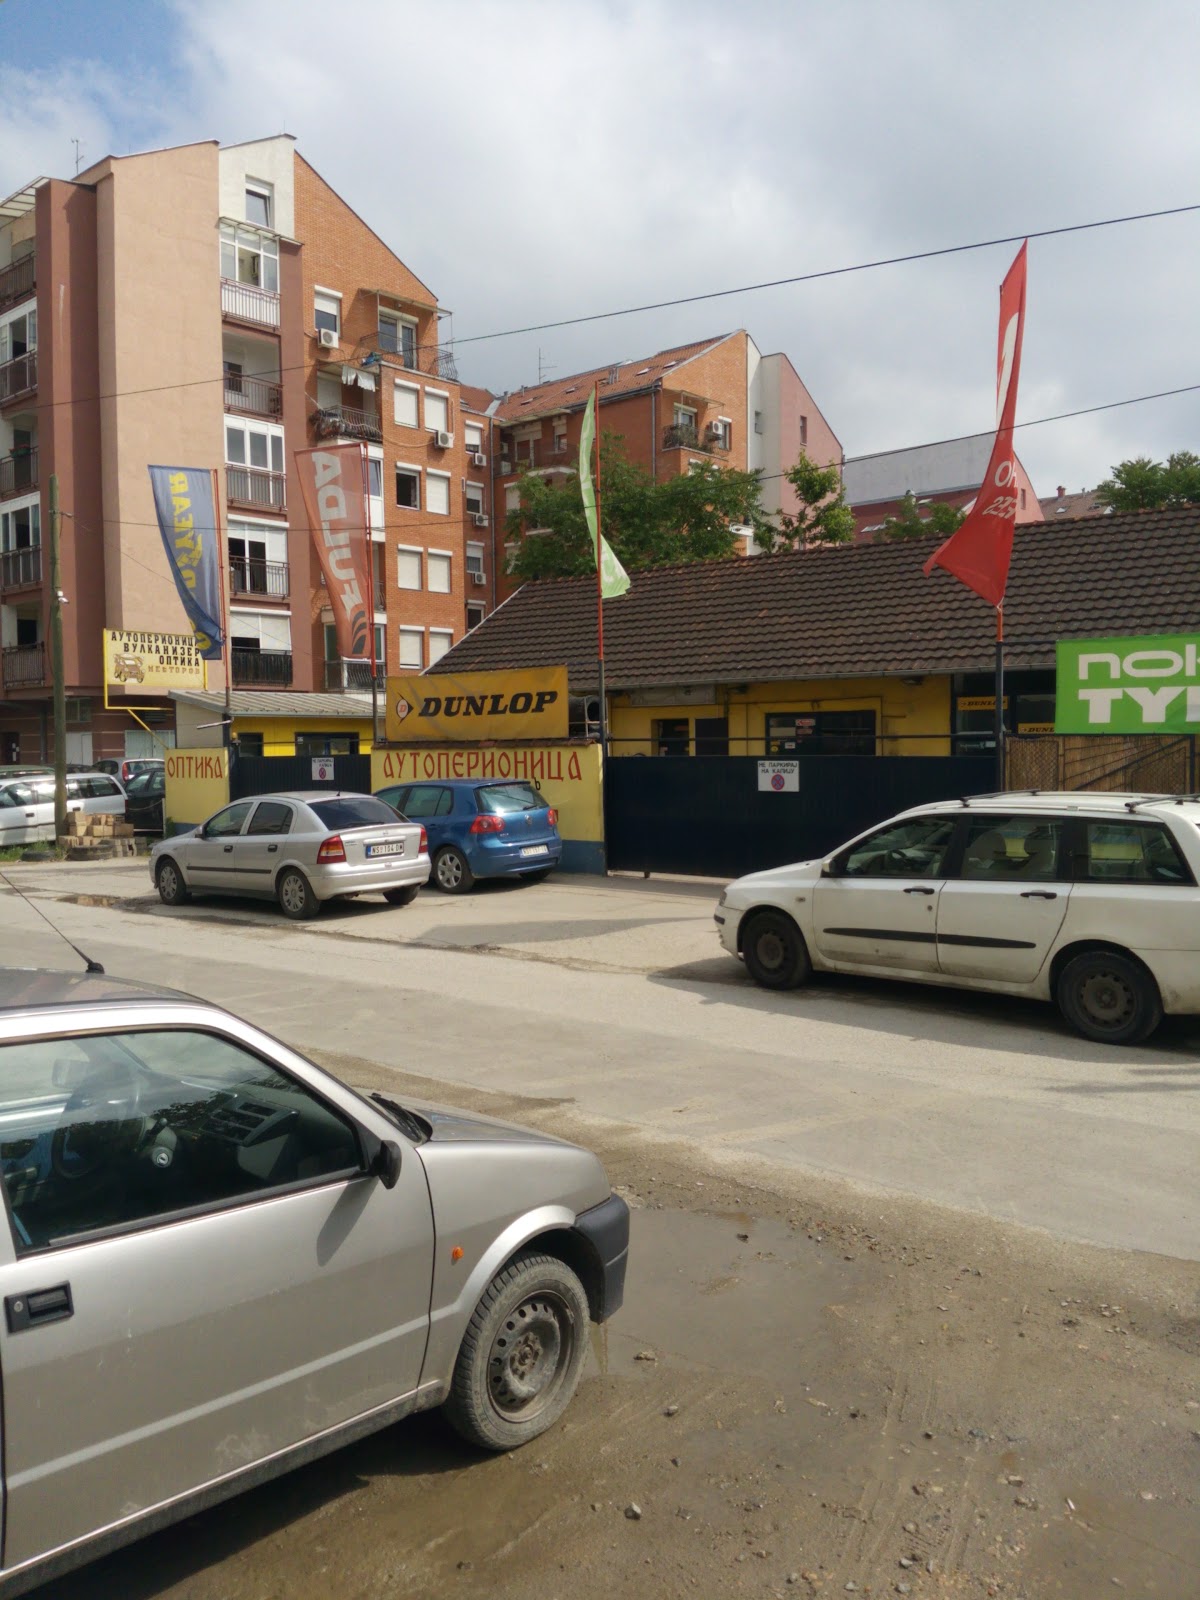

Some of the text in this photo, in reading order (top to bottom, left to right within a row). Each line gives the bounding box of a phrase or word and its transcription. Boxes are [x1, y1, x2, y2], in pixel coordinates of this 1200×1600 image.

[123, 642, 200, 657] ВУЛКАНИЗЕР
[159, 655, 200, 667] ОПТИКА
[418, 690, 558, 717] DUNLOP
[167, 756, 223, 779] ОПТИКА
[383, 751, 582, 782] АУТОПЕРИОНИЦА
